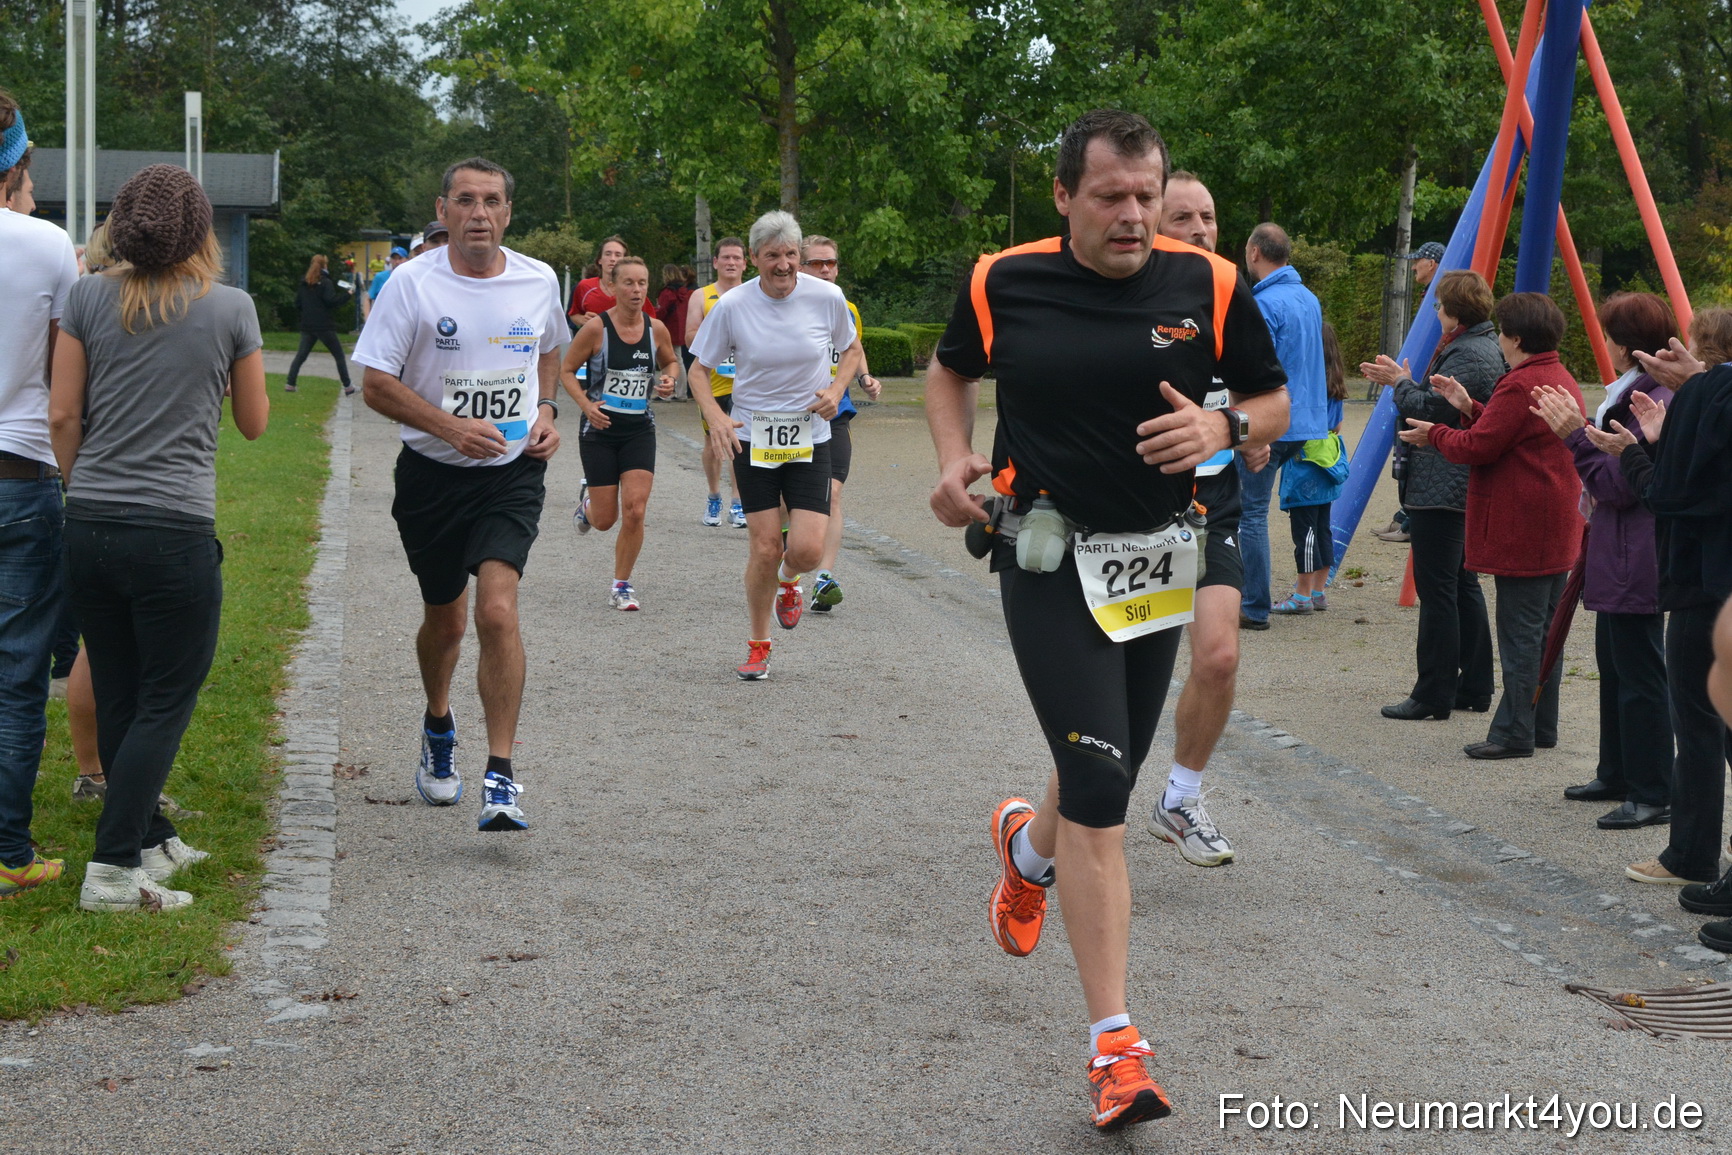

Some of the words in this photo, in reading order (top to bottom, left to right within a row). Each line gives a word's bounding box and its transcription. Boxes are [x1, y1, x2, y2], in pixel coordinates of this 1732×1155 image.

[1157, 325, 1197, 337] Rennsteig
[435, 338, 461, 346] PARTL
[445, 378, 475, 386] PARTL
[477, 377, 515, 387] Neumarkt
[608, 378, 646, 397] 2375
[452, 388, 521, 419] 2052
[765, 425, 800, 446] 162
[764, 451, 801, 460] Bernhard
[1076, 543, 1119, 555] PARTL
[1102, 551, 1173, 598] 224
[1125, 600, 1151, 621] Sigi
